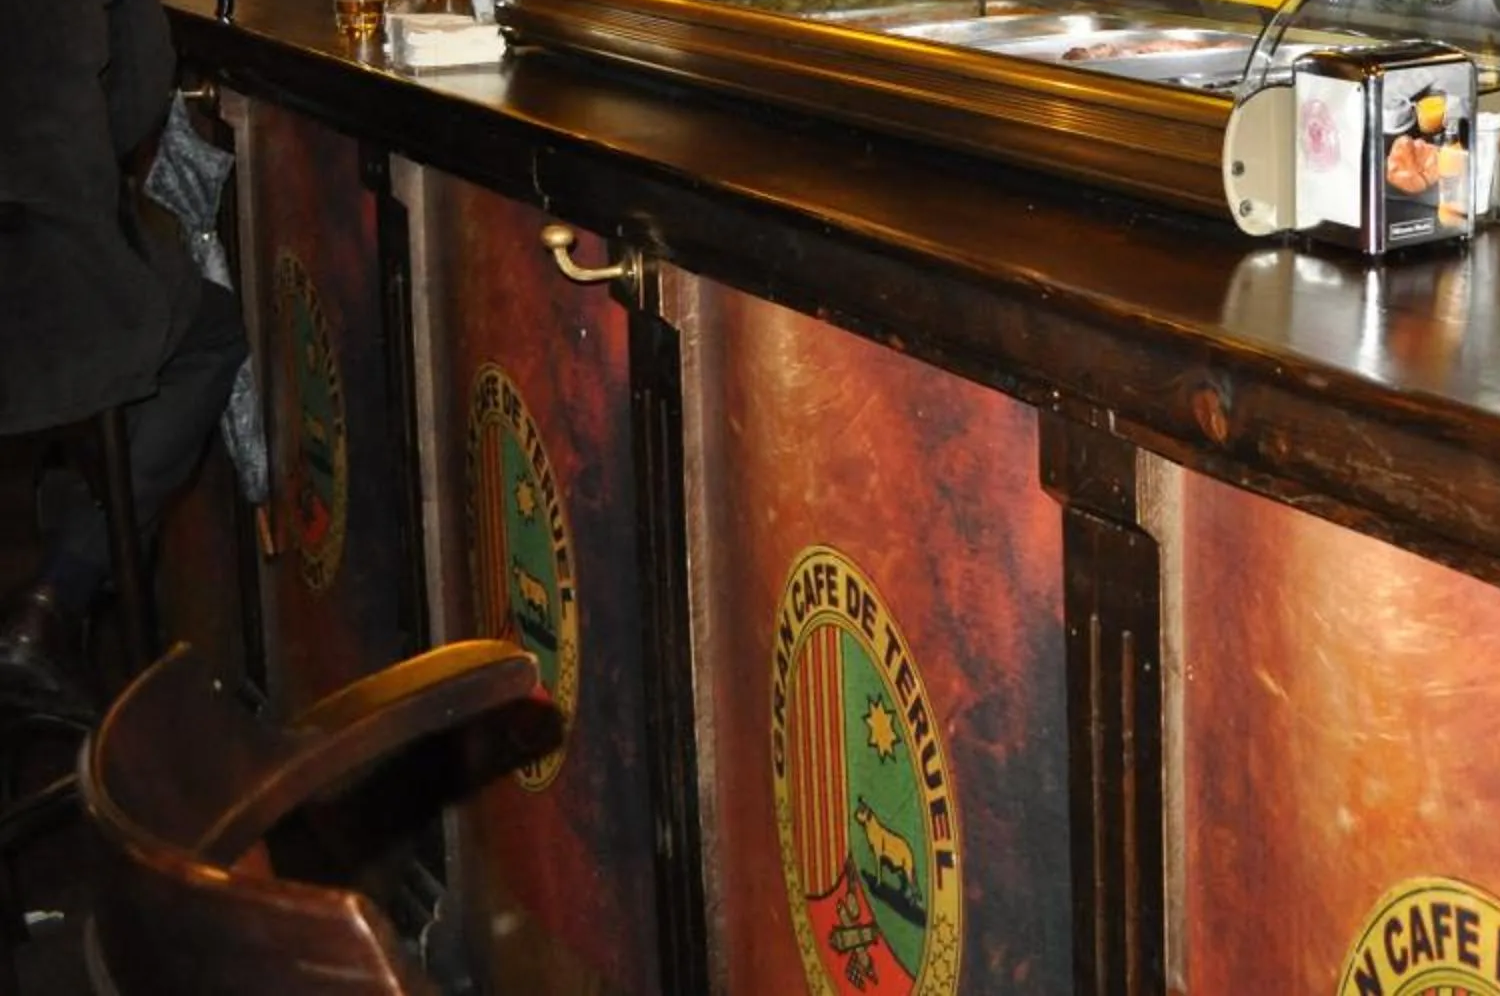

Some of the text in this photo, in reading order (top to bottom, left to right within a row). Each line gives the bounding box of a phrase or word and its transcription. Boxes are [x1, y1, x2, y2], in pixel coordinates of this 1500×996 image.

[791, 562, 840, 617] CAFE
[845, 574, 879, 636] DE
[884, 621, 956, 891] TERUEL
[1383, 902, 1482, 976] CAFE
